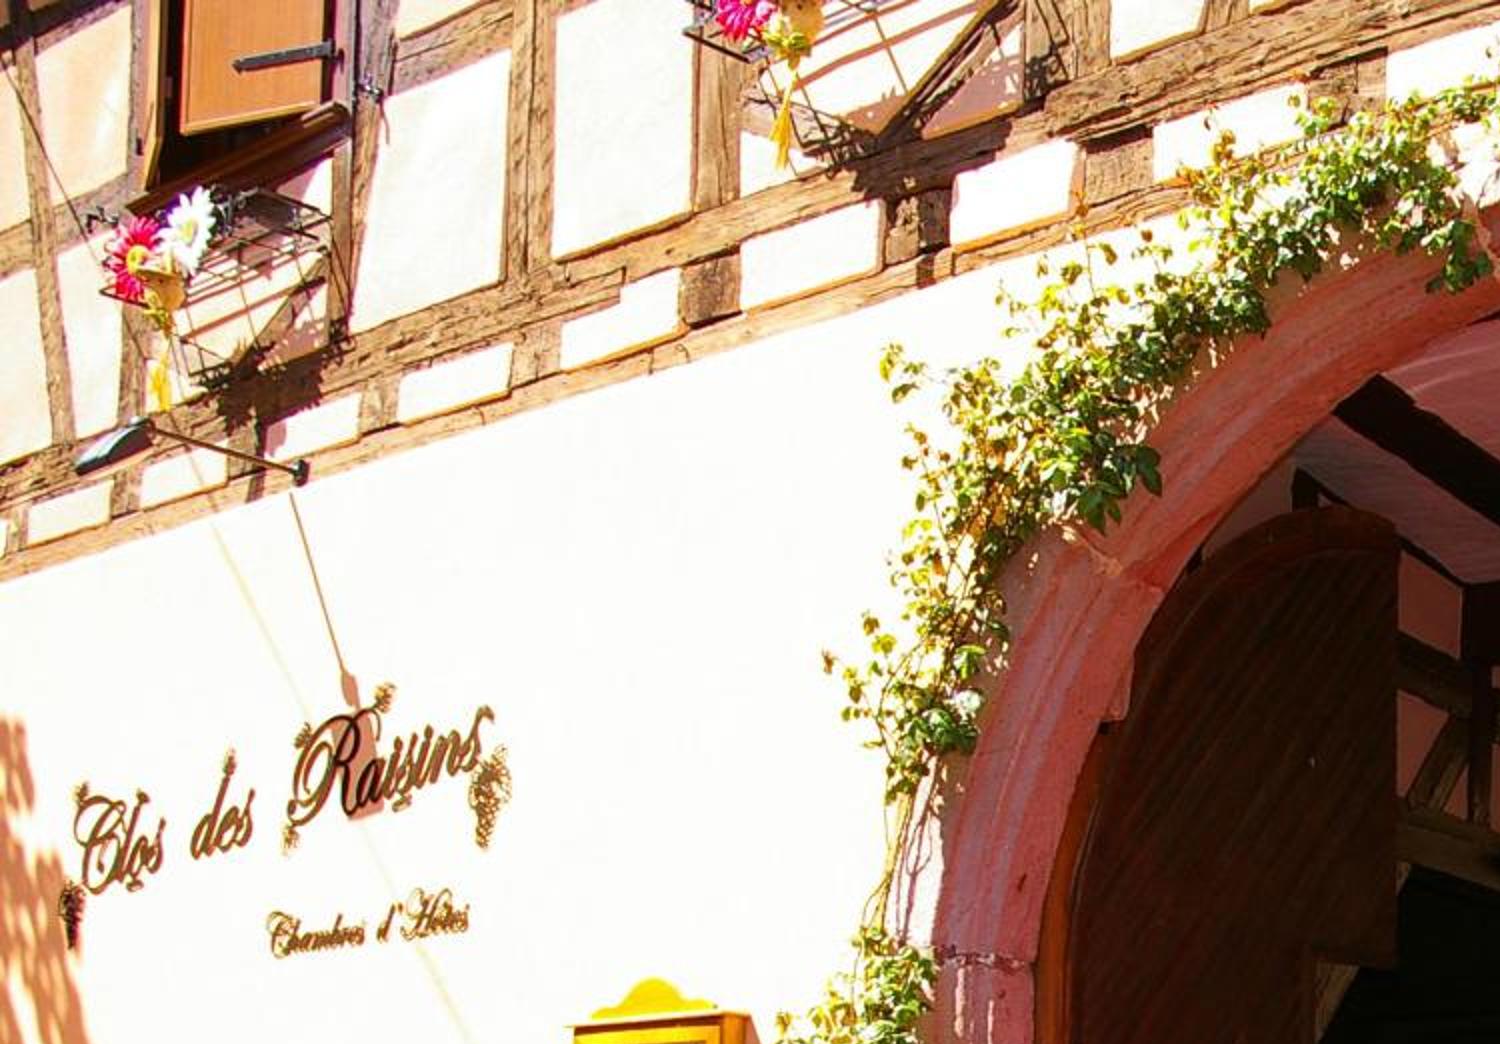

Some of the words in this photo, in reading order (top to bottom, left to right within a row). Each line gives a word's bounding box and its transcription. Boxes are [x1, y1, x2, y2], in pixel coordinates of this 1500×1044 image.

[74, 783, 167, 895] Clos
[190, 750, 256, 860] des
[287, 698, 495, 828] Raisins
